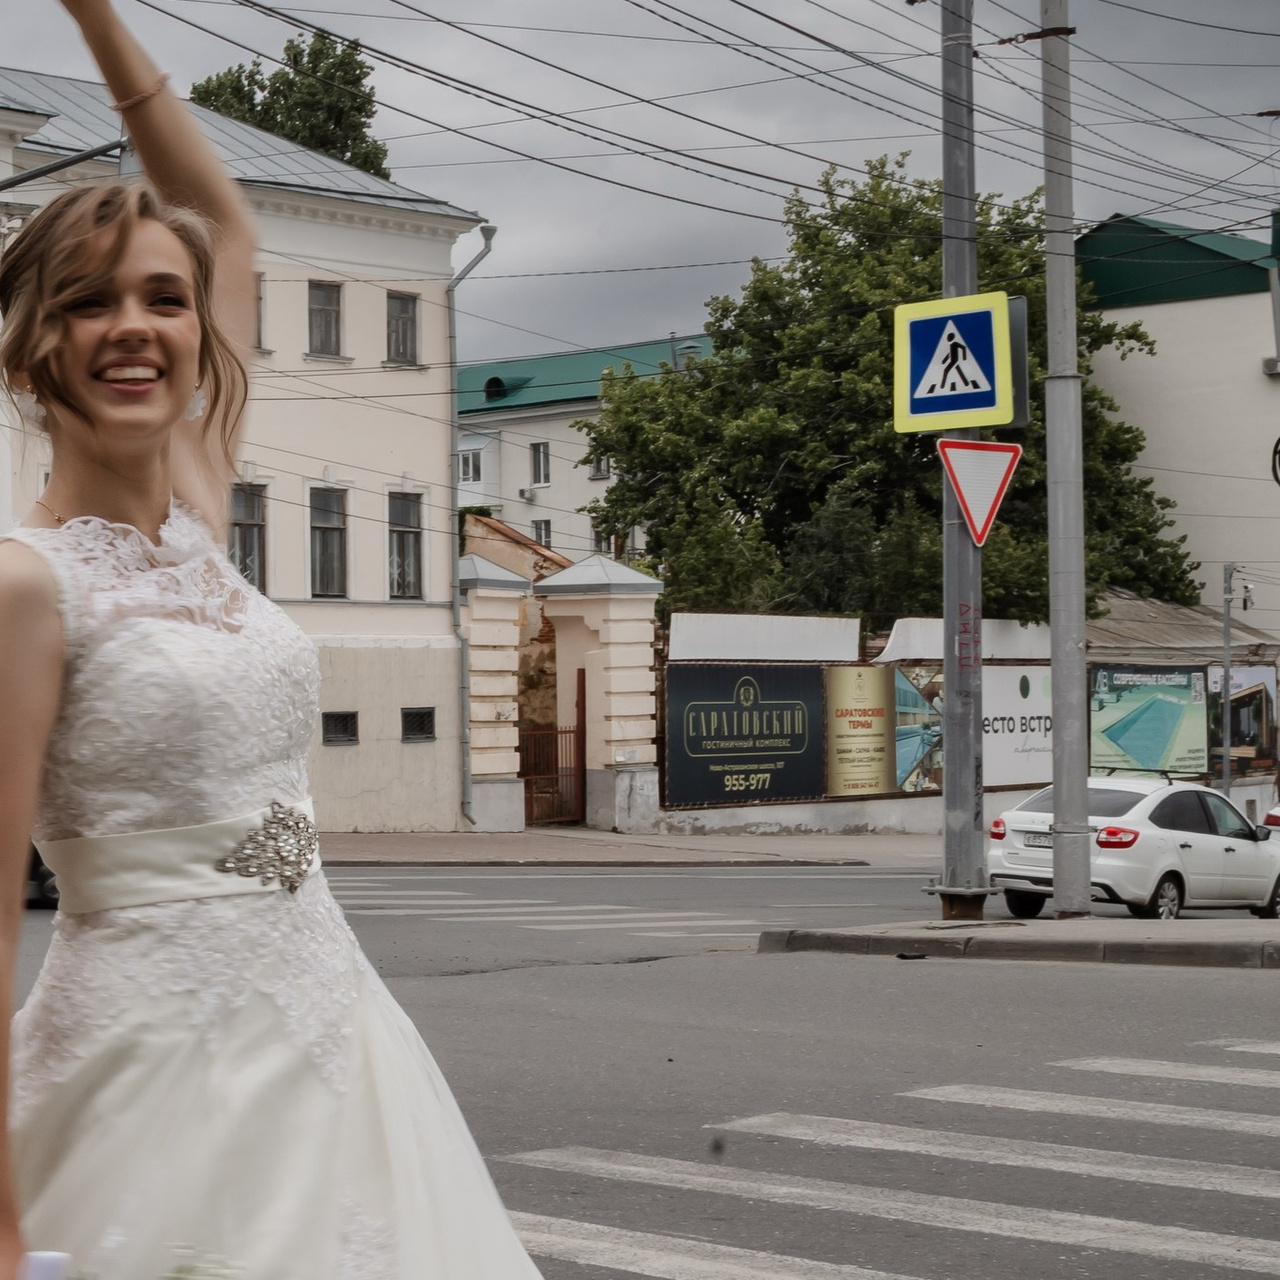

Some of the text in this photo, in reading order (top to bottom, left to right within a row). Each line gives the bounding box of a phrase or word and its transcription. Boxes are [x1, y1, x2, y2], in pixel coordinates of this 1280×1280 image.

[689, 705, 803, 737] САРАТОВСКИЙ
[982, 715, 1052, 738] есто встр
[702, 738, 791, 749] ГОСТИНИЧНЫЙ КОМПЛЕКС
[724, 773, 771, 791] 955-977
